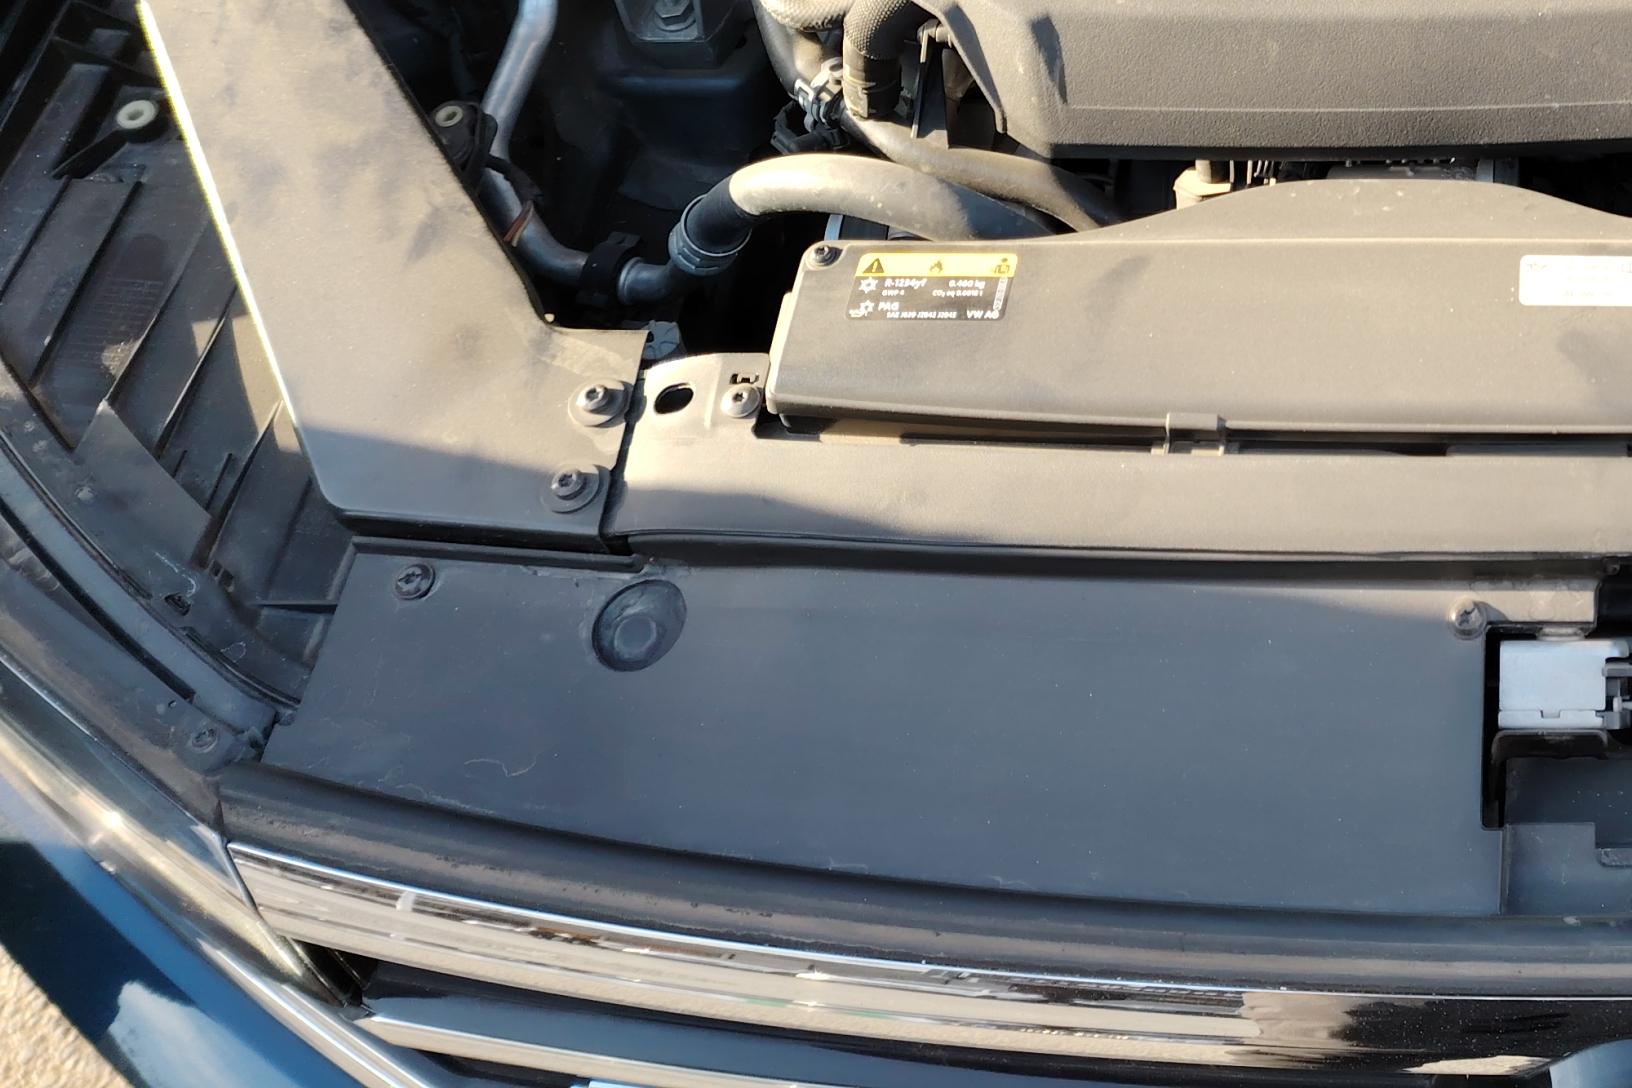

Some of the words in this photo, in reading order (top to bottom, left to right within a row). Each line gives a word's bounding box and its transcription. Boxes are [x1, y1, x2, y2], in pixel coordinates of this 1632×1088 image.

[884, 278, 927, 290] R-1234yf
[878, 301, 900, 311] PAG
[966, 310, 983, 319] VW
[984, 310, 1000, 319] AG
